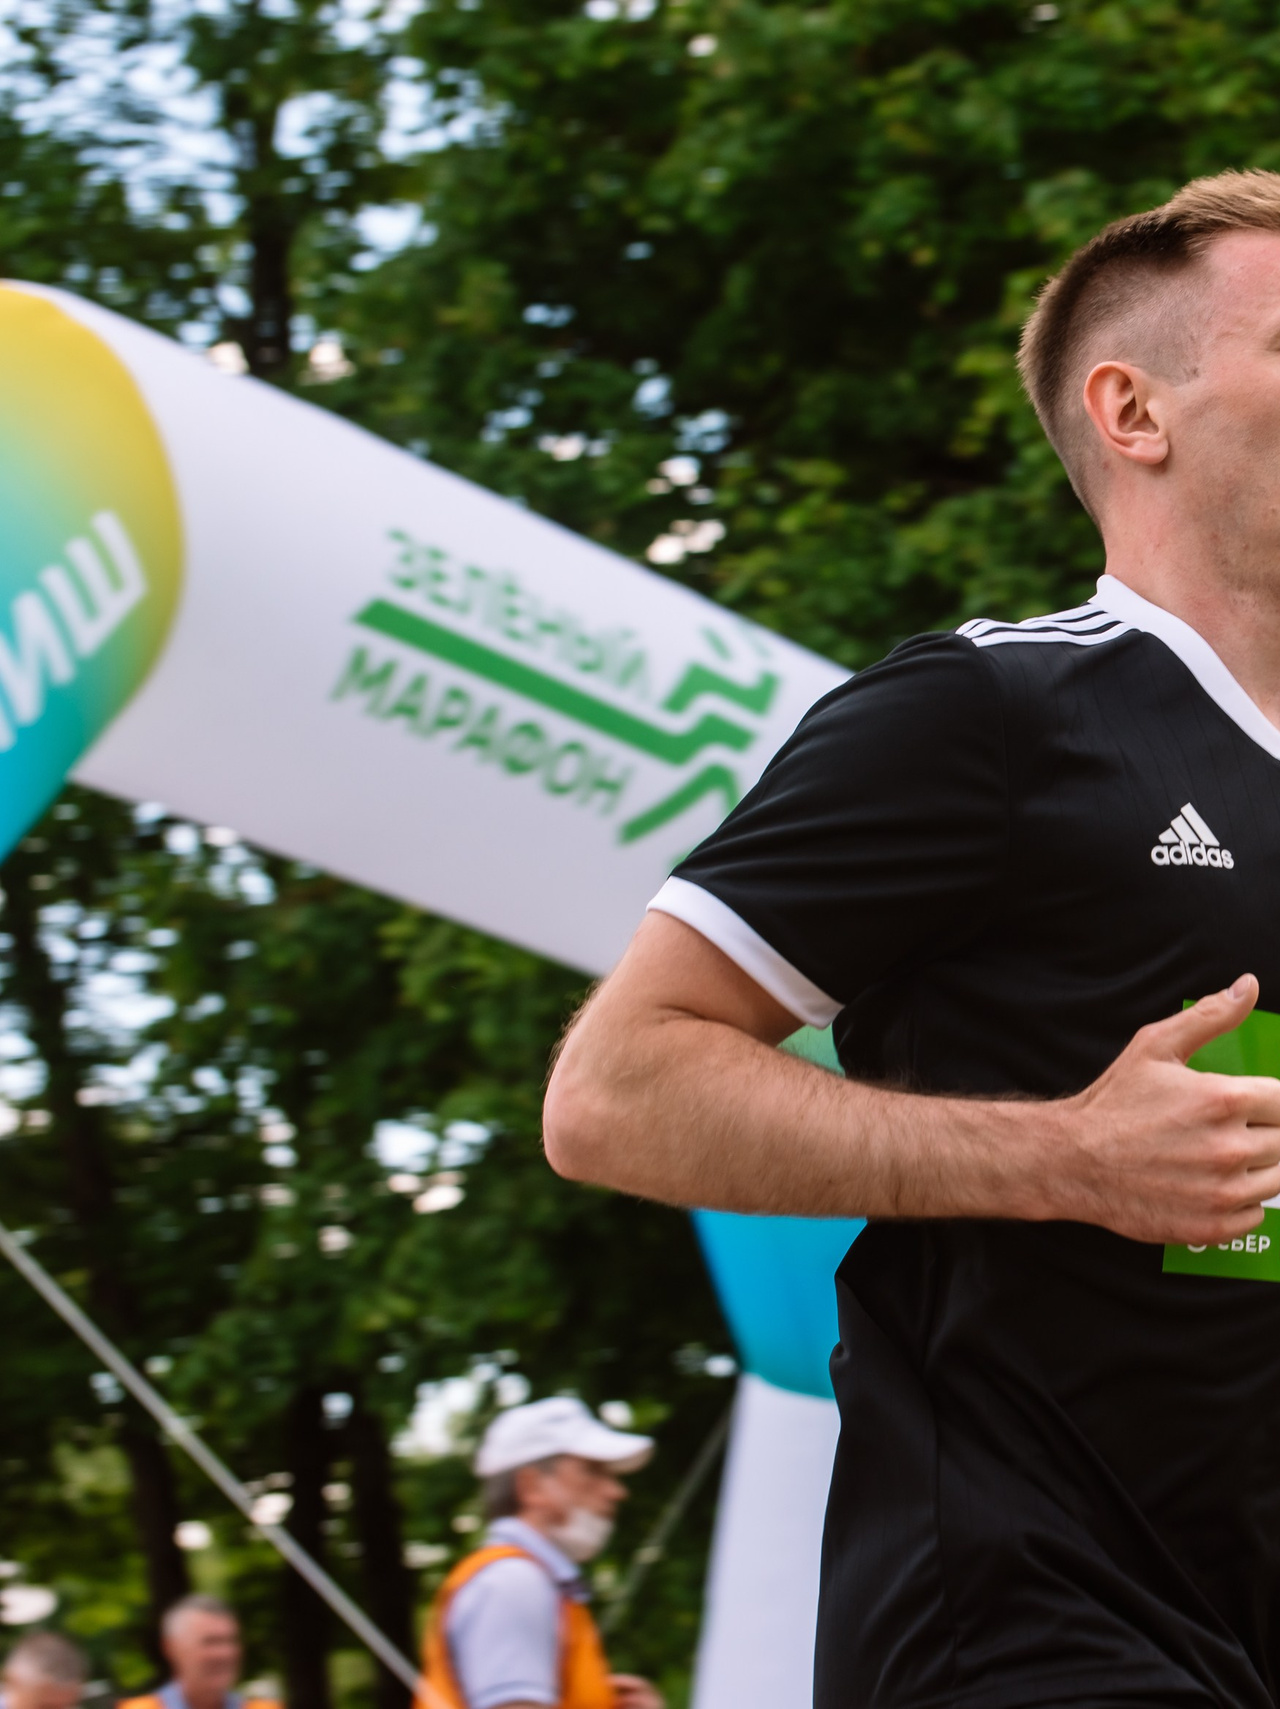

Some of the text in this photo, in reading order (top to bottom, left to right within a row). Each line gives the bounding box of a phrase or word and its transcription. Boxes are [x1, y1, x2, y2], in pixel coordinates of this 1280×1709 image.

[0, 509, 148, 751] ИШ
[331, 642, 635, 817] МАРАФОН
[1150, 840, 1235, 870] adidas
